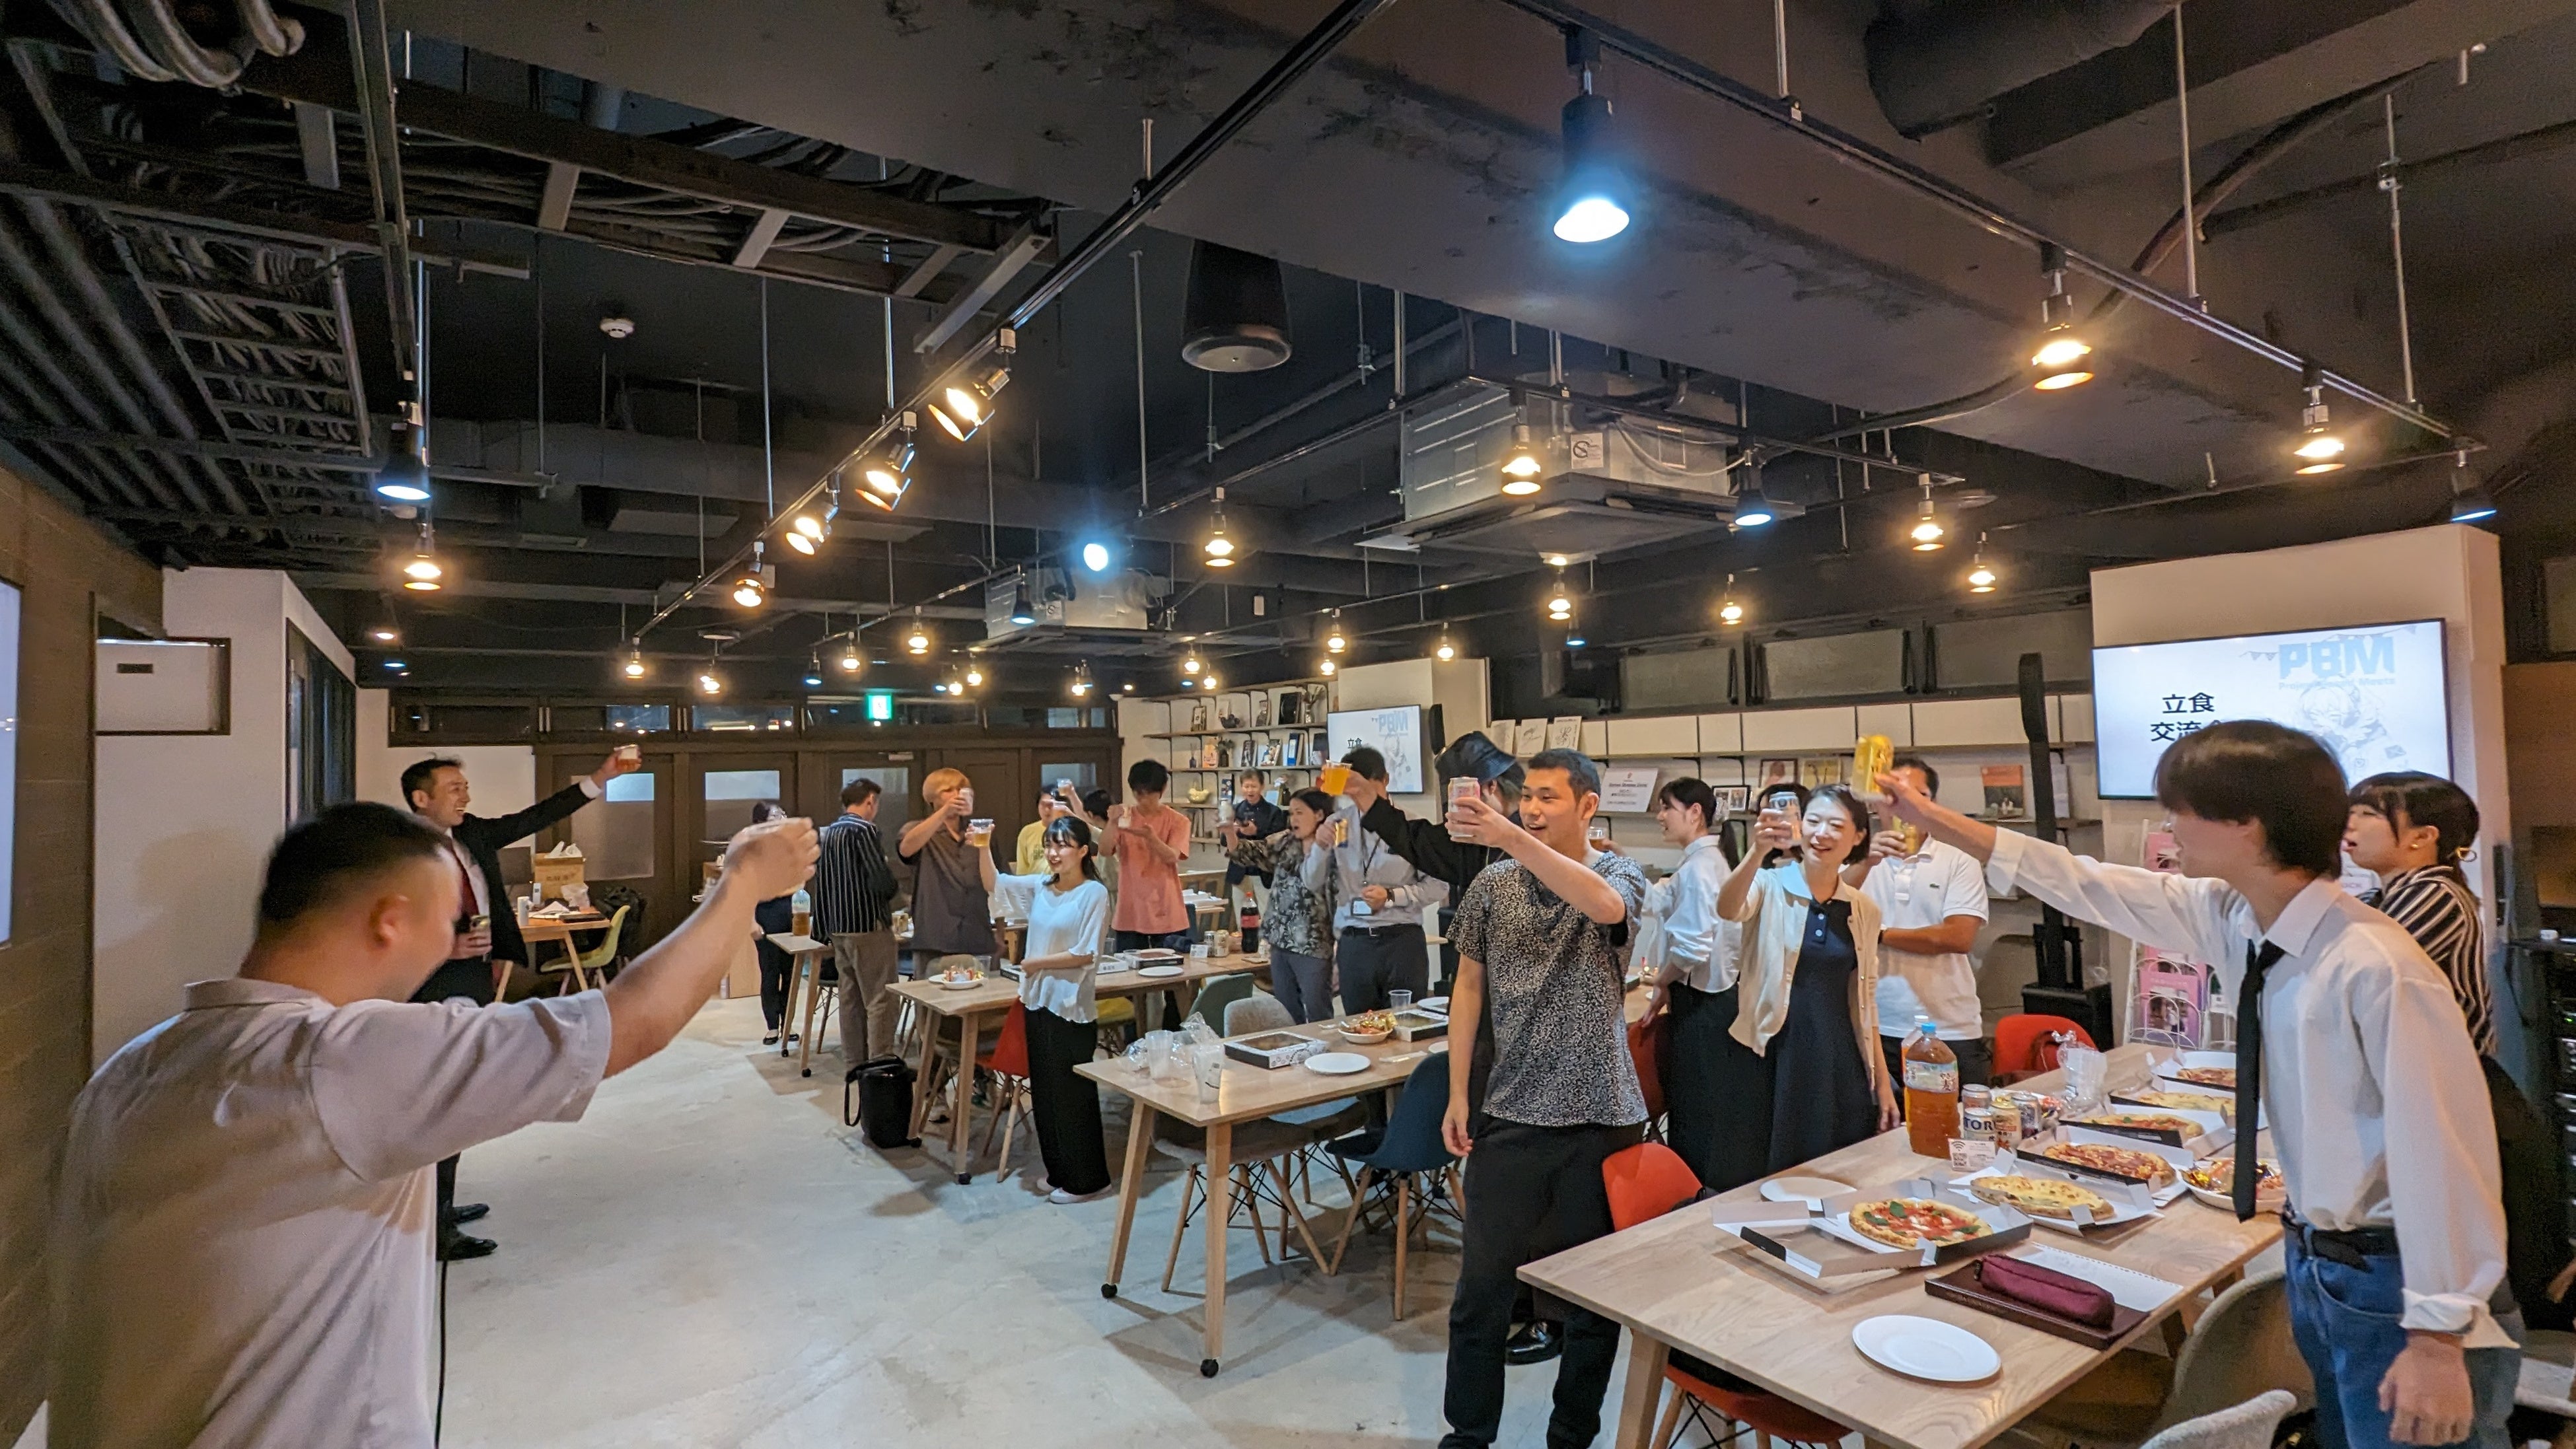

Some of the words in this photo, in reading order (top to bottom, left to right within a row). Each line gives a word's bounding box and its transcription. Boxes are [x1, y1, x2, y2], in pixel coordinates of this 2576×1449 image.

[2279, 635, 2394, 679] PBM
[2163, 692, 2215, 713] 立食
[1378, 712, 1408, 733] PBM
[2151, 720, 2222, 741] 交流
